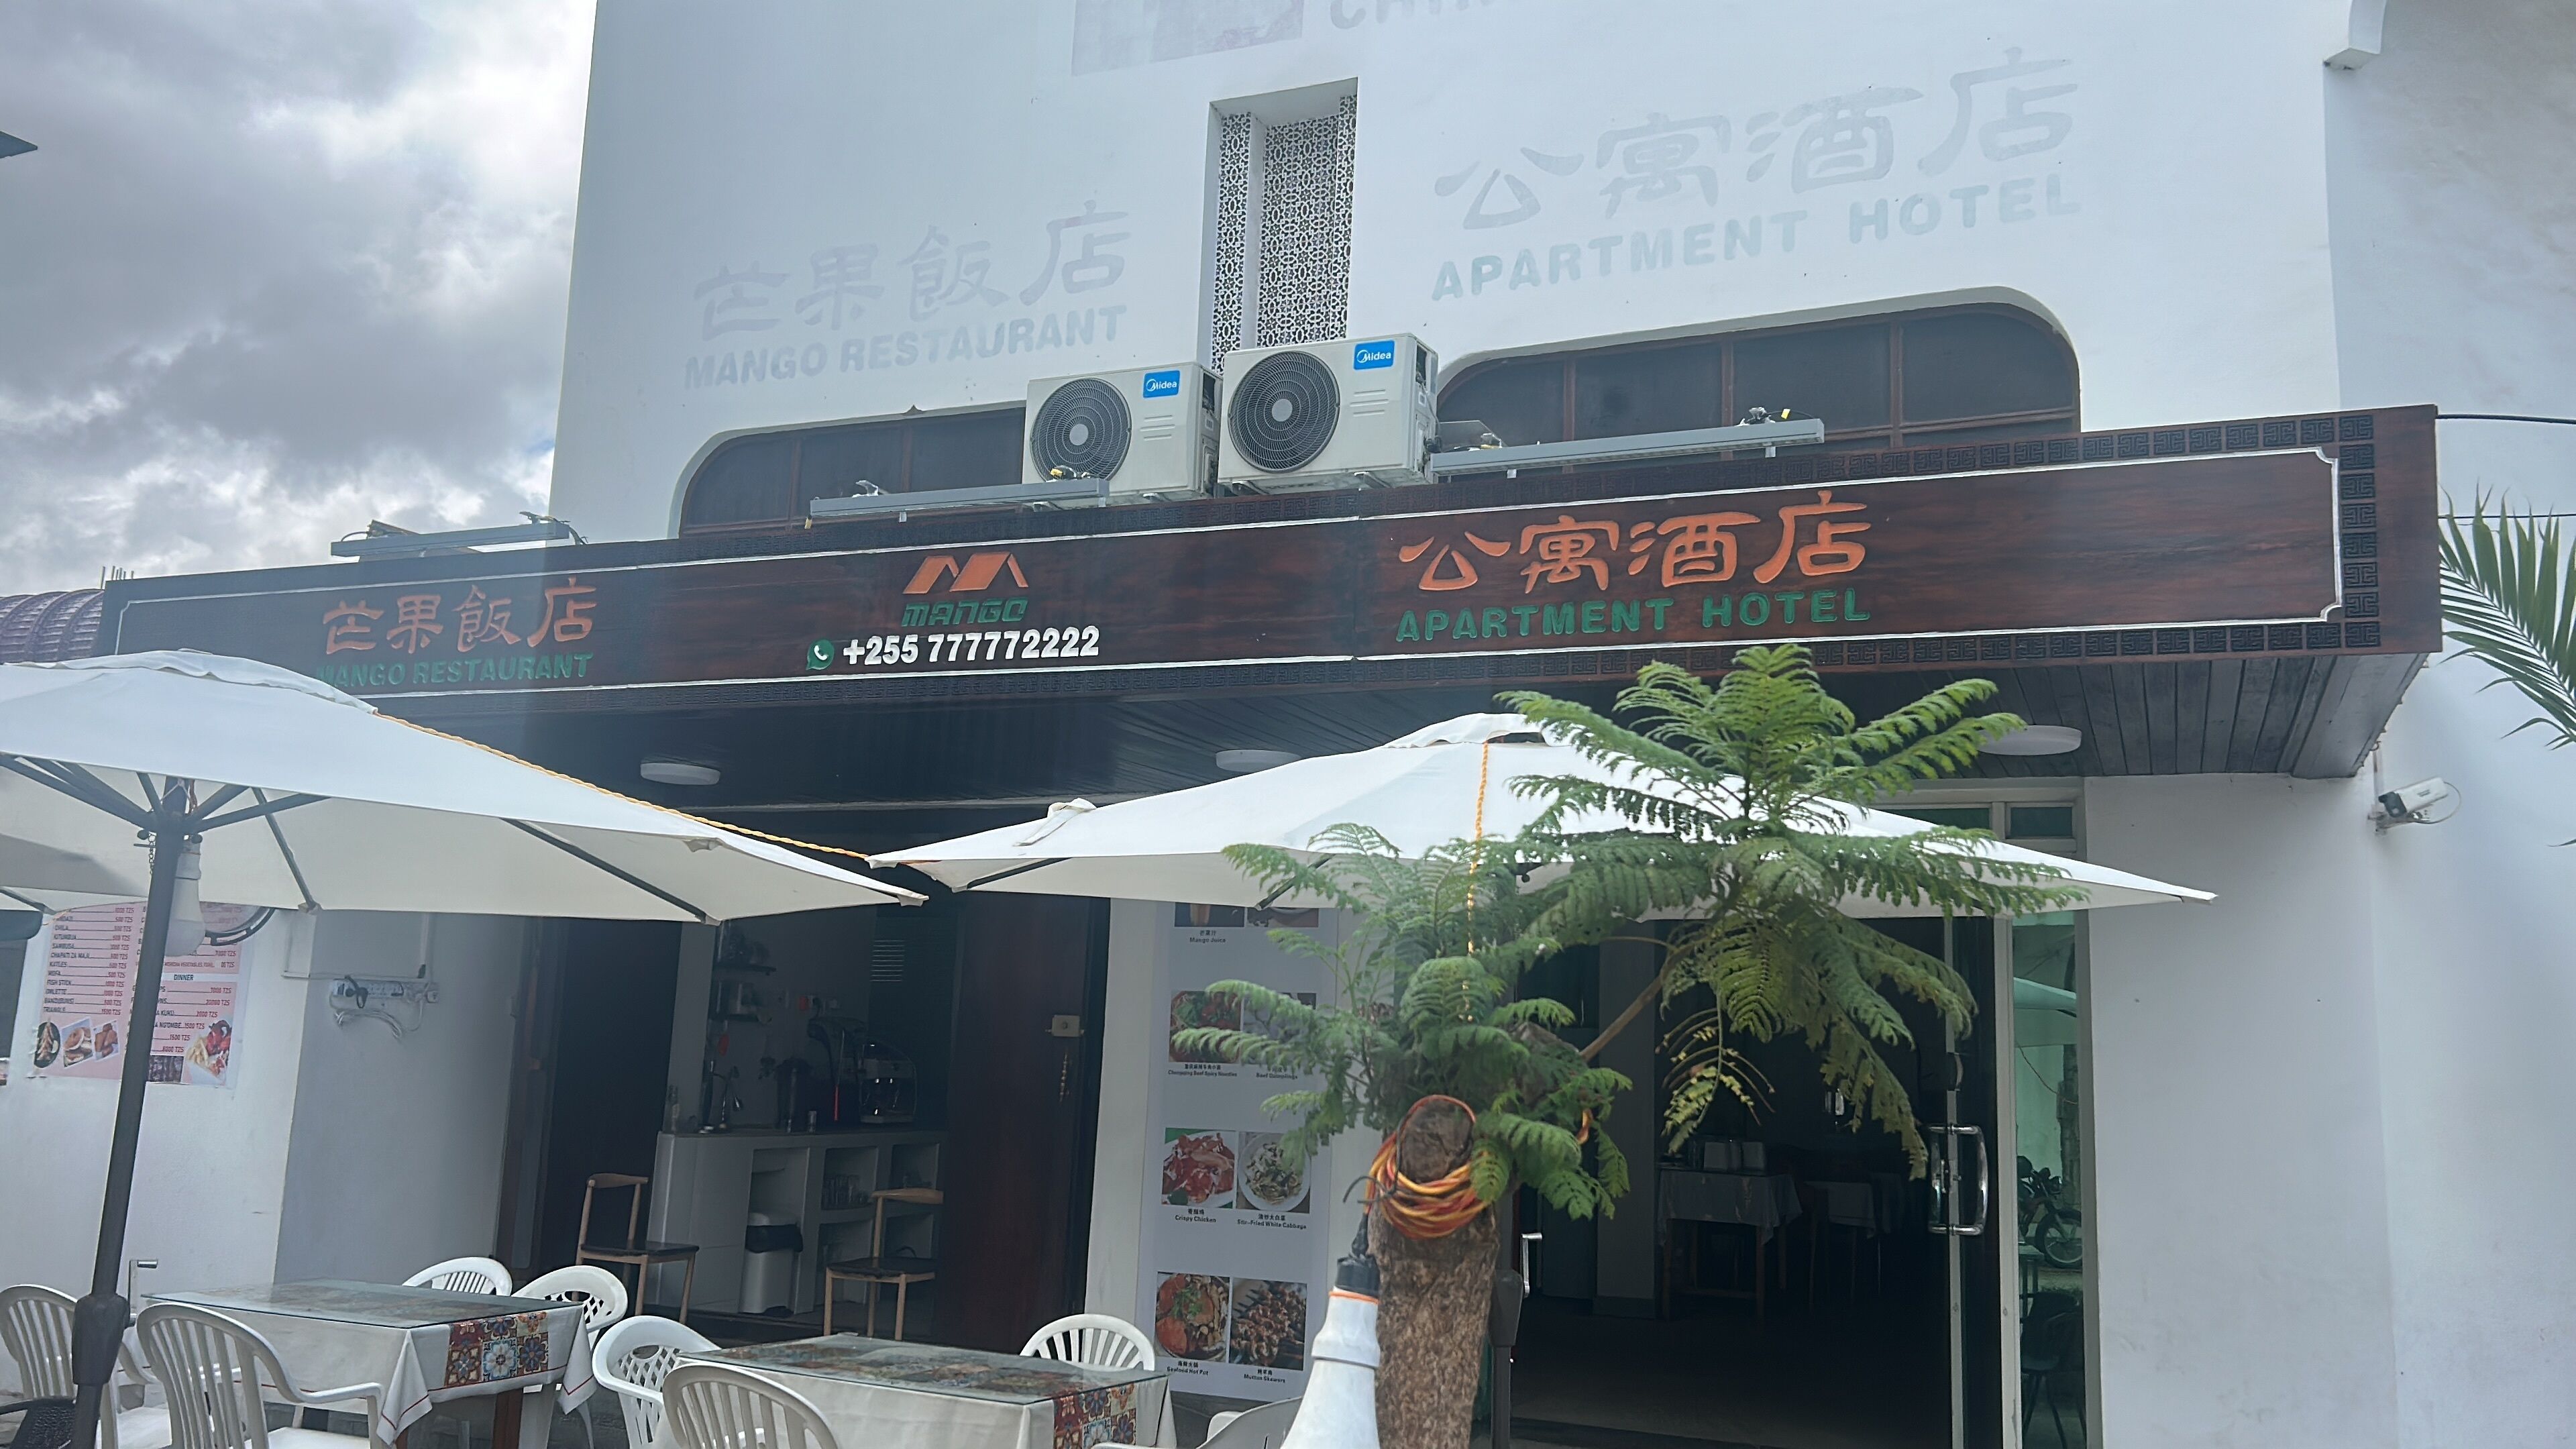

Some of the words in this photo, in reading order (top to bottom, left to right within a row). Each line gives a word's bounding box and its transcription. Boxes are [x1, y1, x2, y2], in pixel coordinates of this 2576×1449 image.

[1434, 46, 2078, 231] 公寓酒店
[1431, 209, 1808, 301] APARTMENT
[1847, 172, 2082, 244] HOTEL
[693, 199, 1131, 342] 芒果飯店
[684, 342, 828, 390] MANGO
[839, 305, 1127, 373] RESTAURANT
[1356, 350, 1391, 363] Midea
[1146, 378, 1177, 392] Midea
[1399, 490, 1871, 594] 公寓酒店
[323, 576, 597, 655] 芒果飯店
[843, 634, 919, 665] +255
[927, 625, 1100, 662] 777772222
[901, 596, 1029, 627] MANGO
[1395, 598, 1674, 643] APARTMENT
[1702, 588, 1870, 629] HOTEL
[317, 663, 406, 687] MANGO
[413, 651, 594, 684] RESTAURANT
